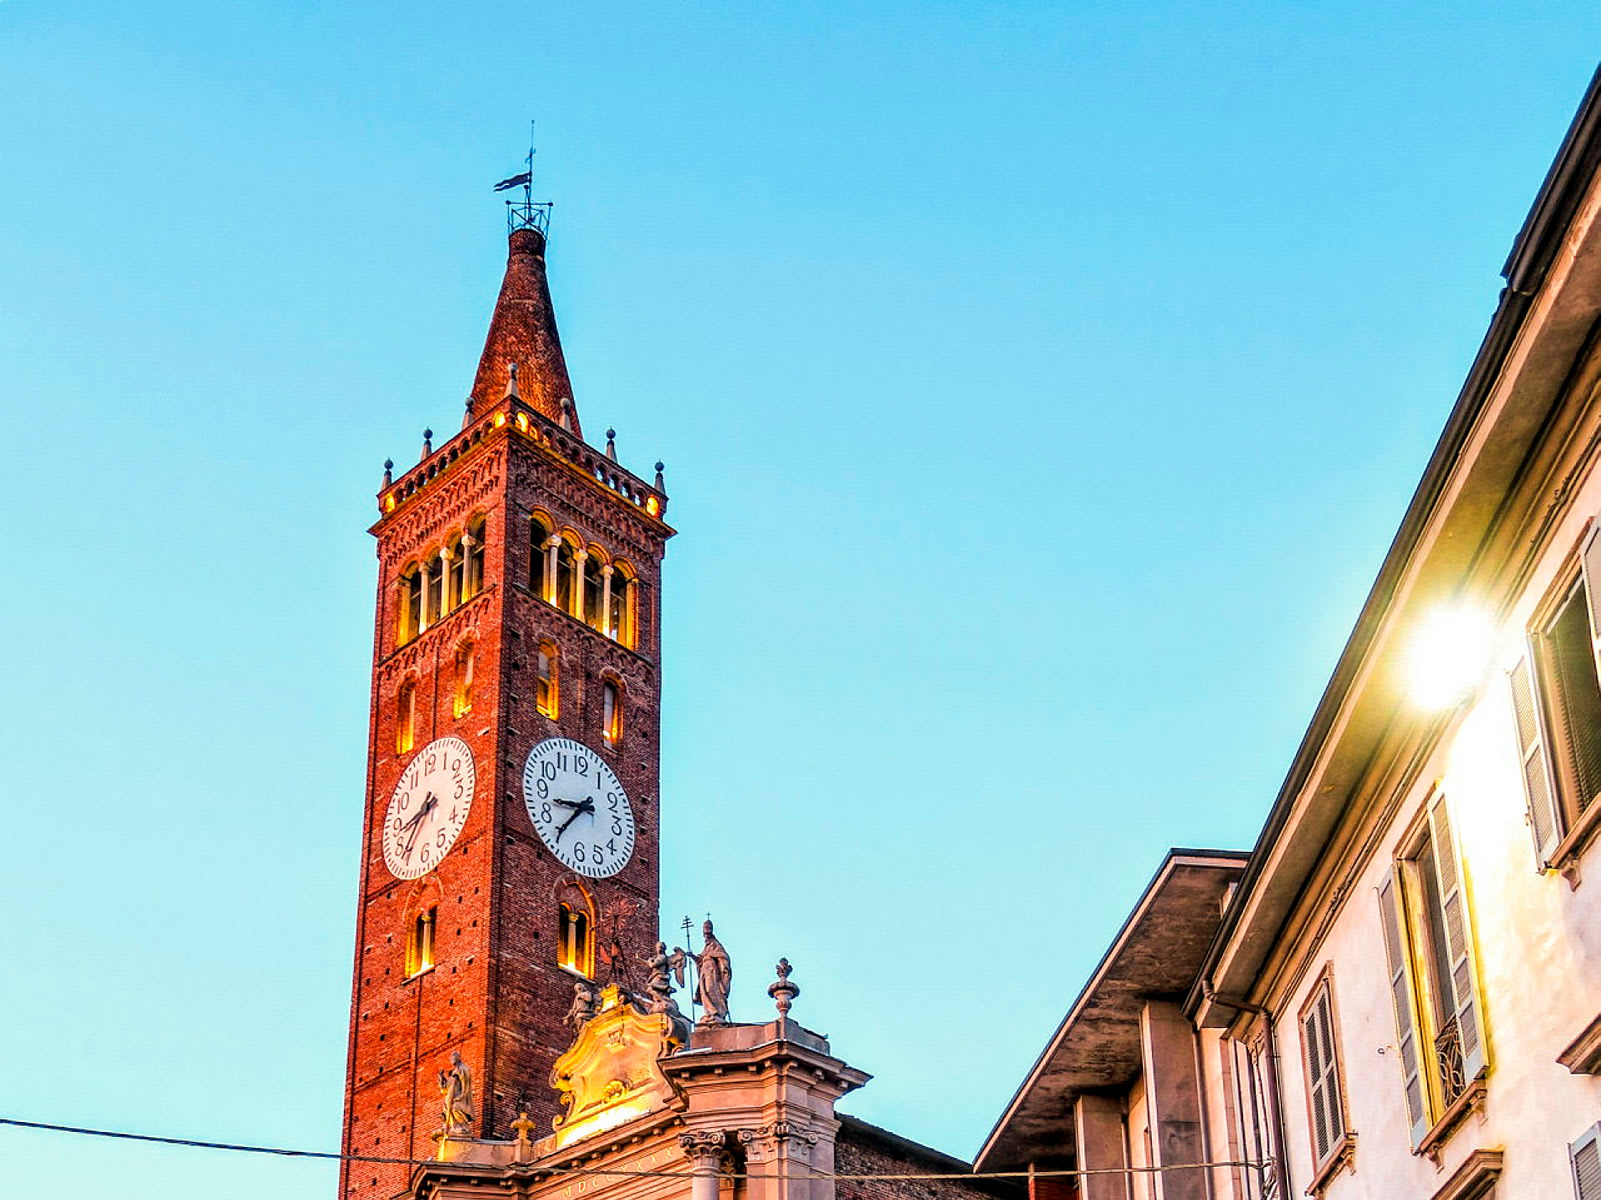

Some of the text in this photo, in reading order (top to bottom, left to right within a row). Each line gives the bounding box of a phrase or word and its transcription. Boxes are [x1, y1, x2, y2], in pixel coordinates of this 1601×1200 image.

[424, 753, 437, 777] 12
[451, 759, 461, 780] 2
[540, 760, 556, 781] 10
[556, 751, 568, 773] 11
[573, 755, 589, 778] 12
[409, 771, 419, 791] 11
[453, 778, 463, 800] 3
[536, 778, 549, 799] 9
[397, 791, 410, 815] 10
[541, 802, 552, 824] 8
[607, 792, 618, 814] 2
[448, 804, 458, 824] 4
[611, 815, 622, 836] 3
[395, 837, 404, 857] 8
[436, 828, 445, 849] 5
[606, 838, 617, 856] 4
[420, 842, 430, 864] 6
[573, 841, 585, 863] 6
[592, 844, 604, 865] 5
